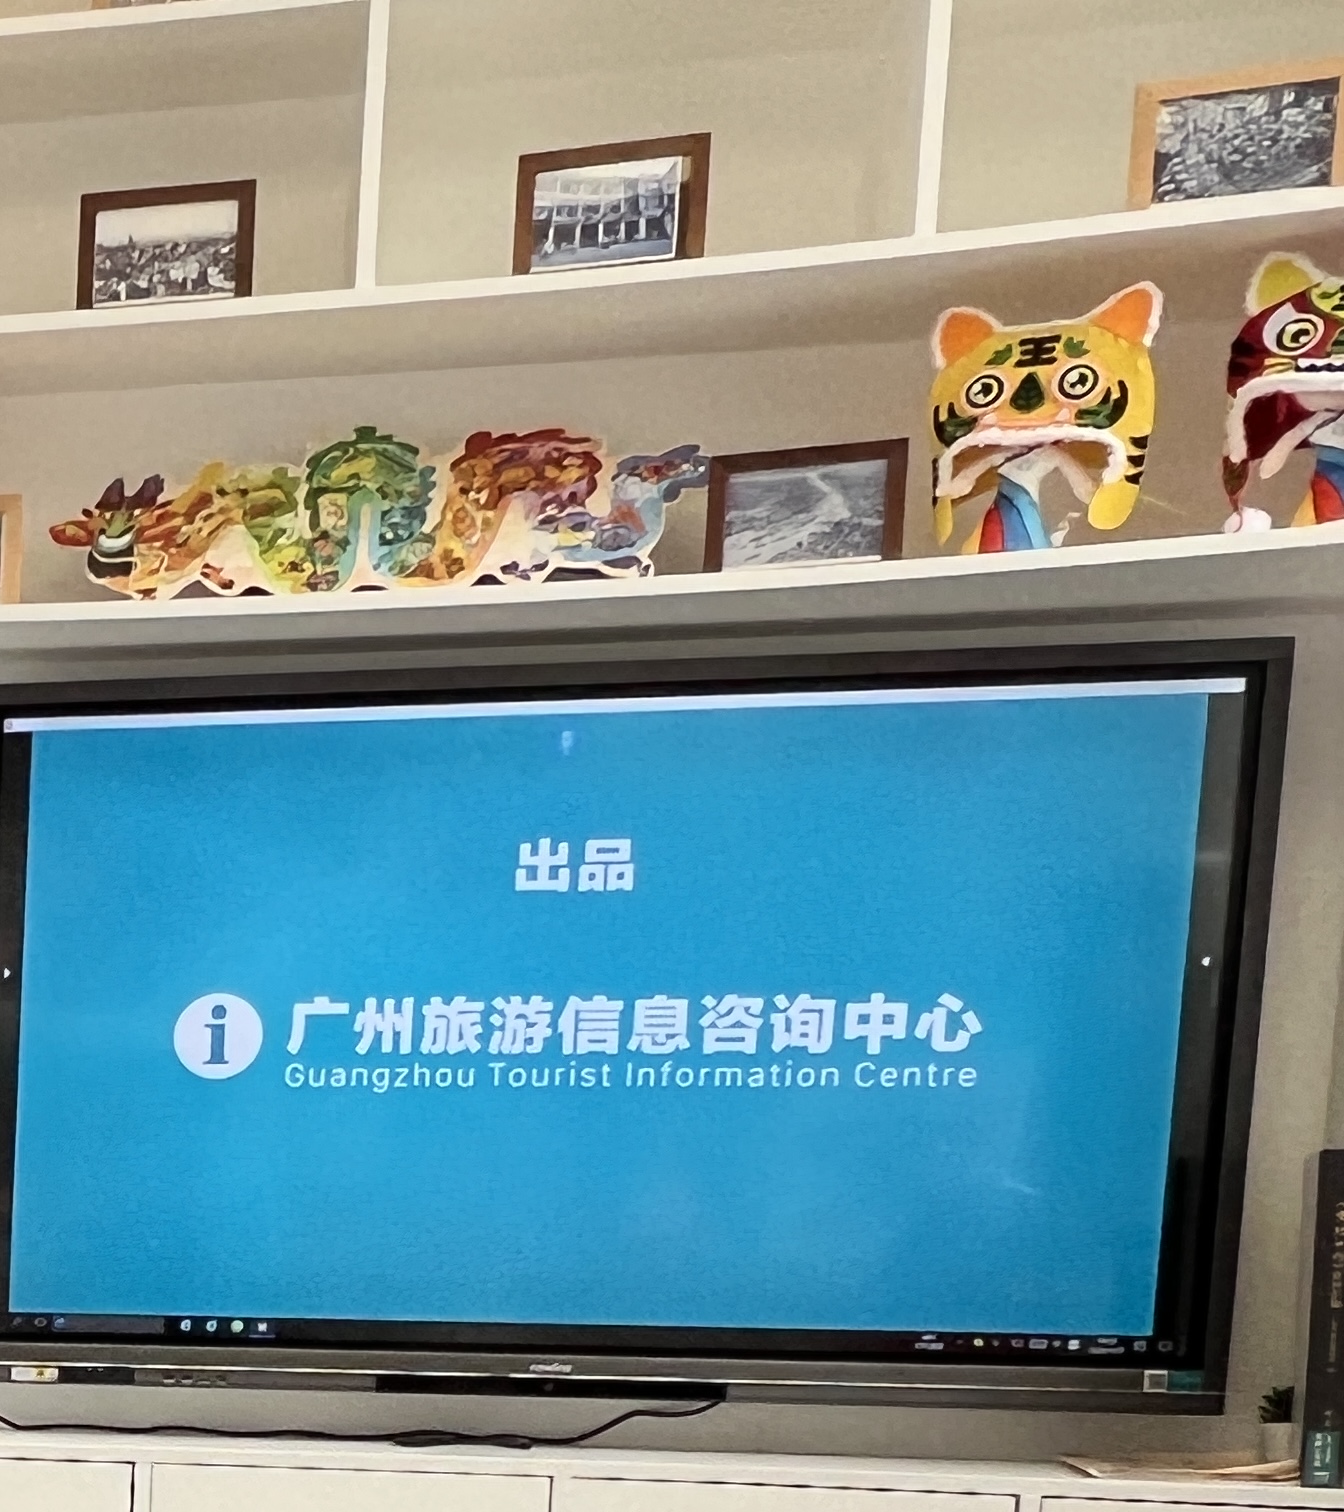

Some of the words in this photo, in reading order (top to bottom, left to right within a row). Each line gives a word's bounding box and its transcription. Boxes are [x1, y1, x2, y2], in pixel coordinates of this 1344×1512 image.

[514, 837, 635, 893] 出品
[286, 992, 984, 1057] 广州旅游信息咨询中心
[284, 1063, 476, 1093] Guangzhou
[488, 1059, 612, 1088] Tourist
[625, 1060, 841, 1088] Information
[854, 1060, 978, 1088] Centre
